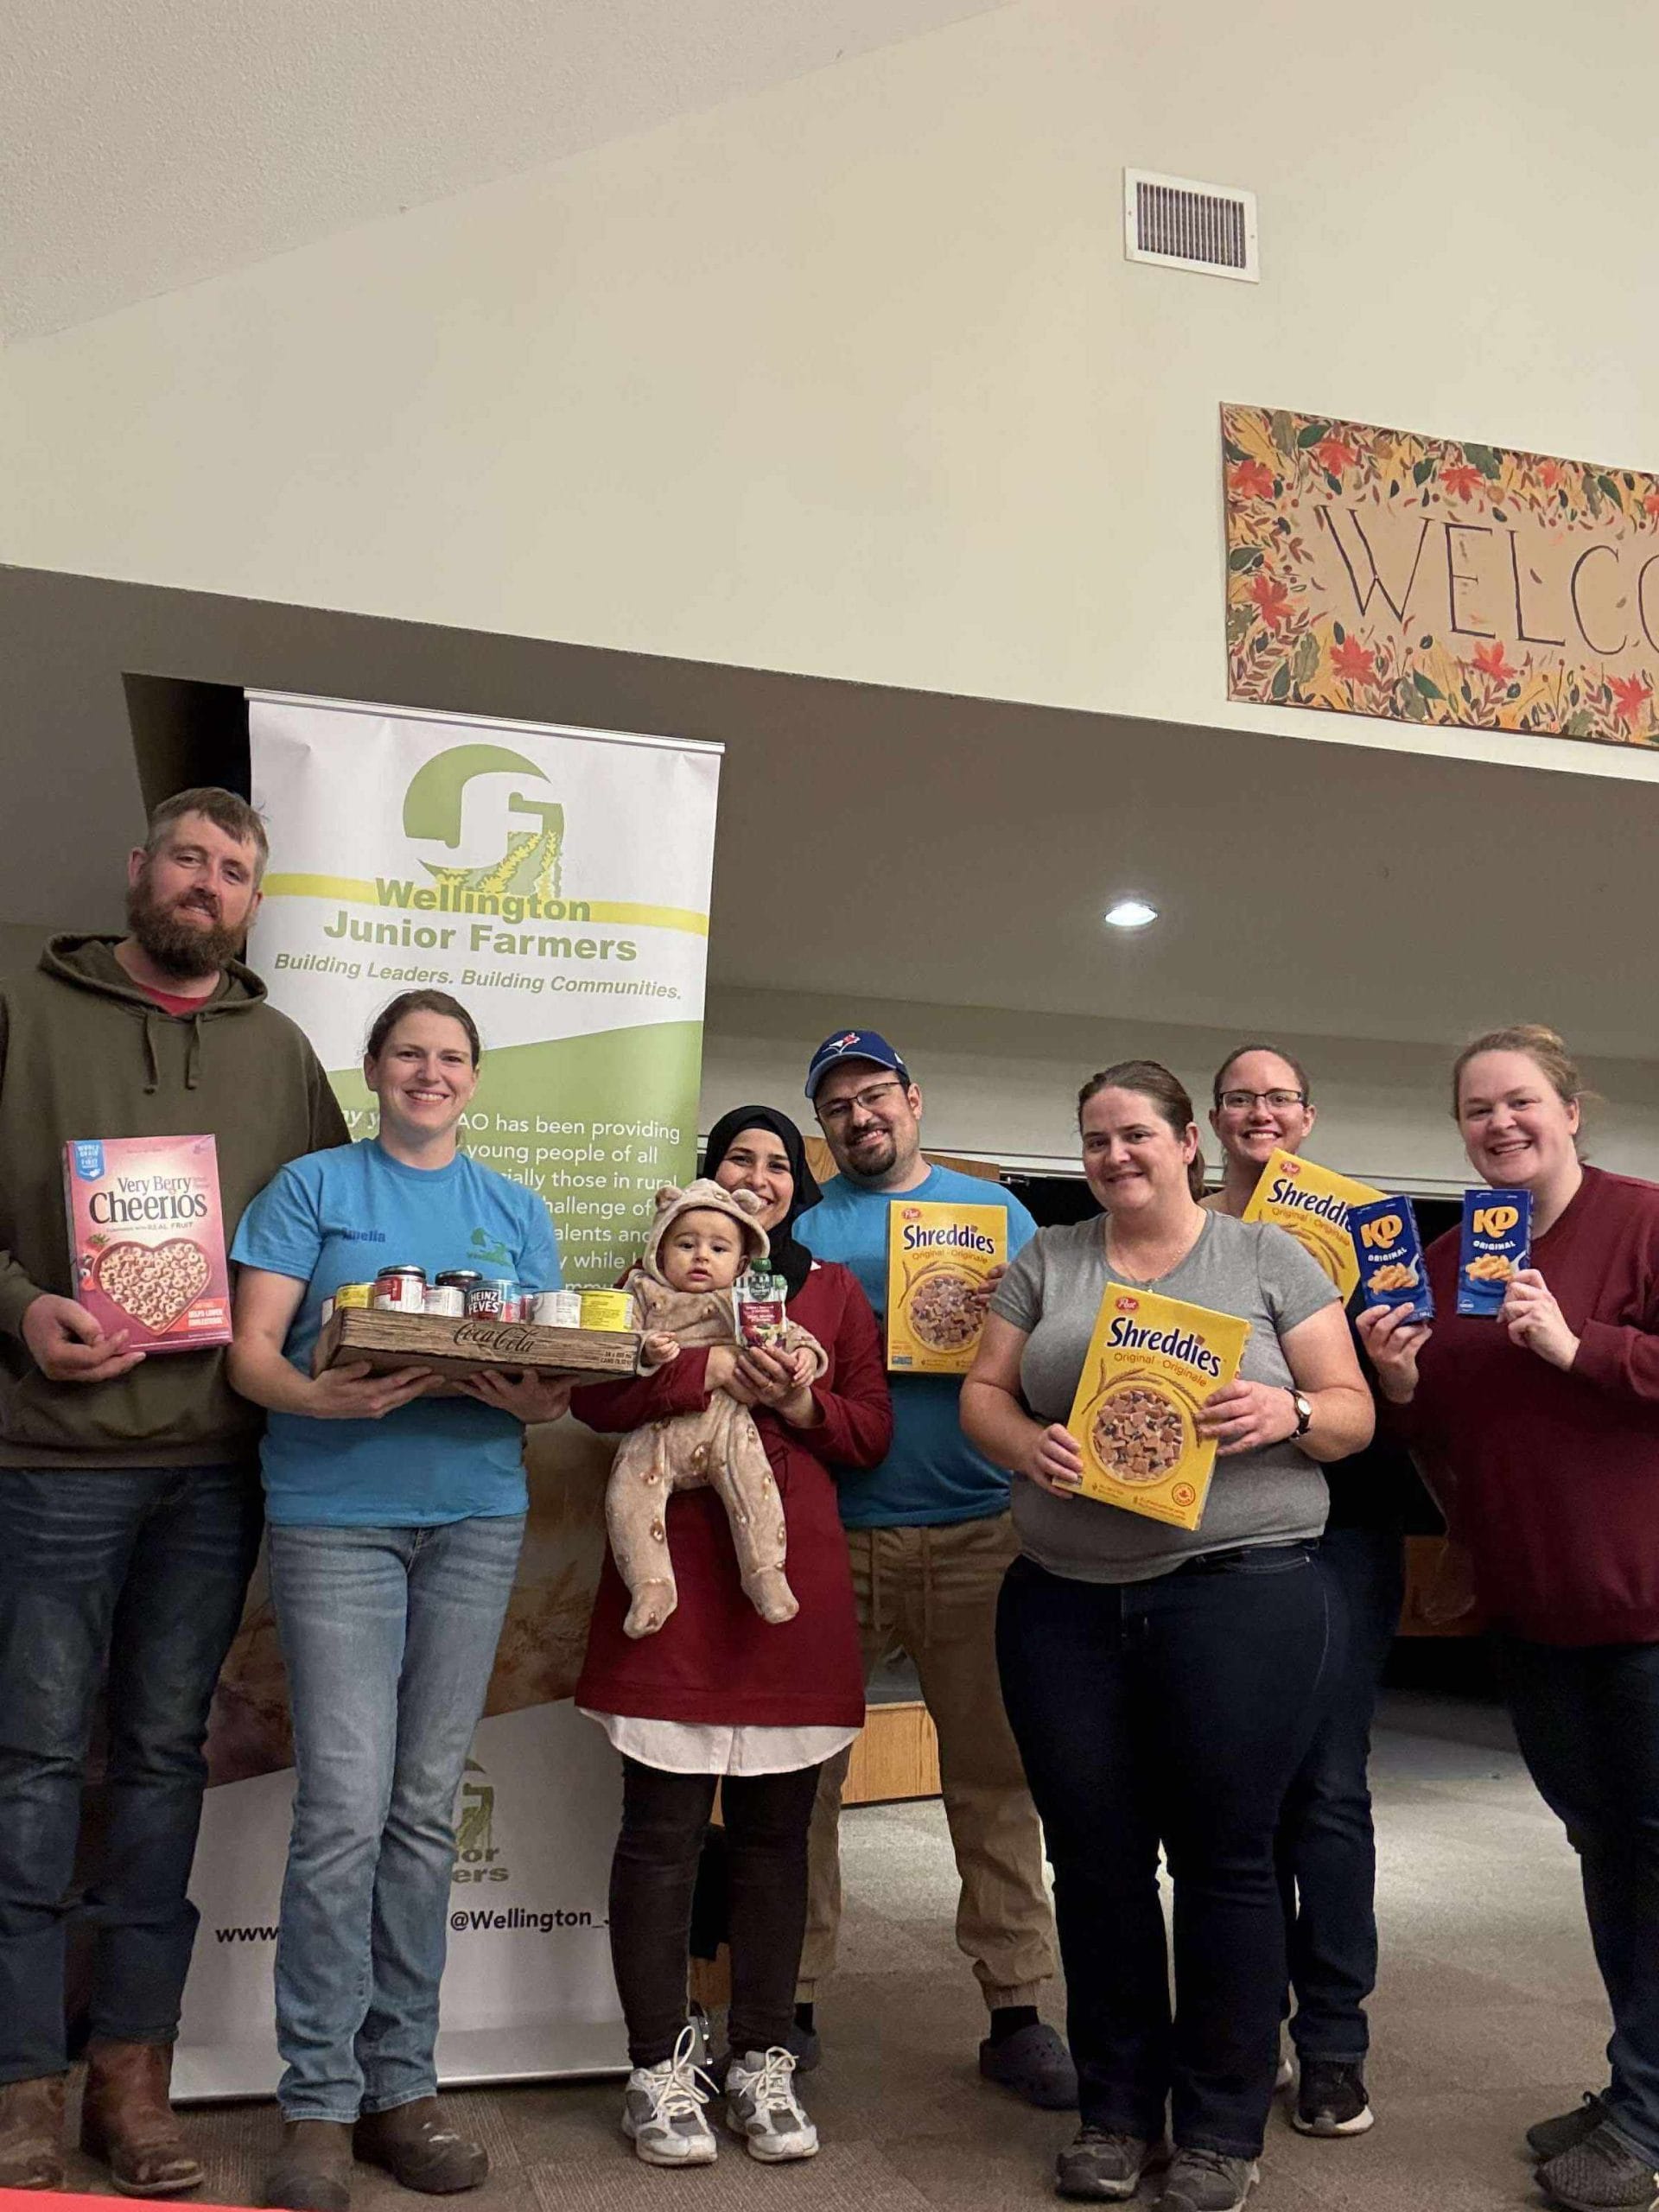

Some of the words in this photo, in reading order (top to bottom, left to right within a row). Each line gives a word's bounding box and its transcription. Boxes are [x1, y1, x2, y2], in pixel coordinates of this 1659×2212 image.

[374, 876, 591, 925] Wellington
[323, 911, 456, 950] Junior
[469, 924, 638, 962] Farmers
[274, 952, 359, 979] Building
[367, 962, 454, 985] Leaders.
[461, 969, 544, 994] Building
[550, 975, 682, 1001] Communities.
[456, 1113, 489, 1131] AO
[495, 1114, 529, 1134] has
[536, 1116, 585, 1135] been
[592, 1120, 681, 1146] providing
[466, 1144, 529, 1164] young
[535, 1143, 605, 1166] people
[612, 1144, 632, 1162] of
[636, 1146, 658, 1164] all
[117, 1176, 150, 1196] Very
[153, 1175, 192, 1194] Berry
[551, 1169, 607, 1189] those
[613, 1171, 631, 1189] in
[636, 1175, 677, 1190] rural
[89, 1189, 208, 1224] Cheerios
[543, 1196, 626, 1220] hallenge
[632, 1198, 652, 1216] of
[1266, 1179, 1350, 1232] Shreddi
[554, 1224, 612, 1243] alents
[903, 1224, 995, 1255] Shreddies
[1472, 1240, 1516, 1250] ORIGINAL
[573, 1250, 626, 1270] while
[912, 1249, 944, 1261] Original
[950, 1249, 988, 1264] Originale
[1367, 1246, 1408, 1262] ORIGINAL
[470, 1290, 499, 1304] HEINZ
[1106, 1316, 1222, 1377] Shreddies
[1114, 1351, 1155, 1365] Original
[1162, 1359, 1207, 1388] Originale
[449, 1908, 610, 1934] @Wellington_
